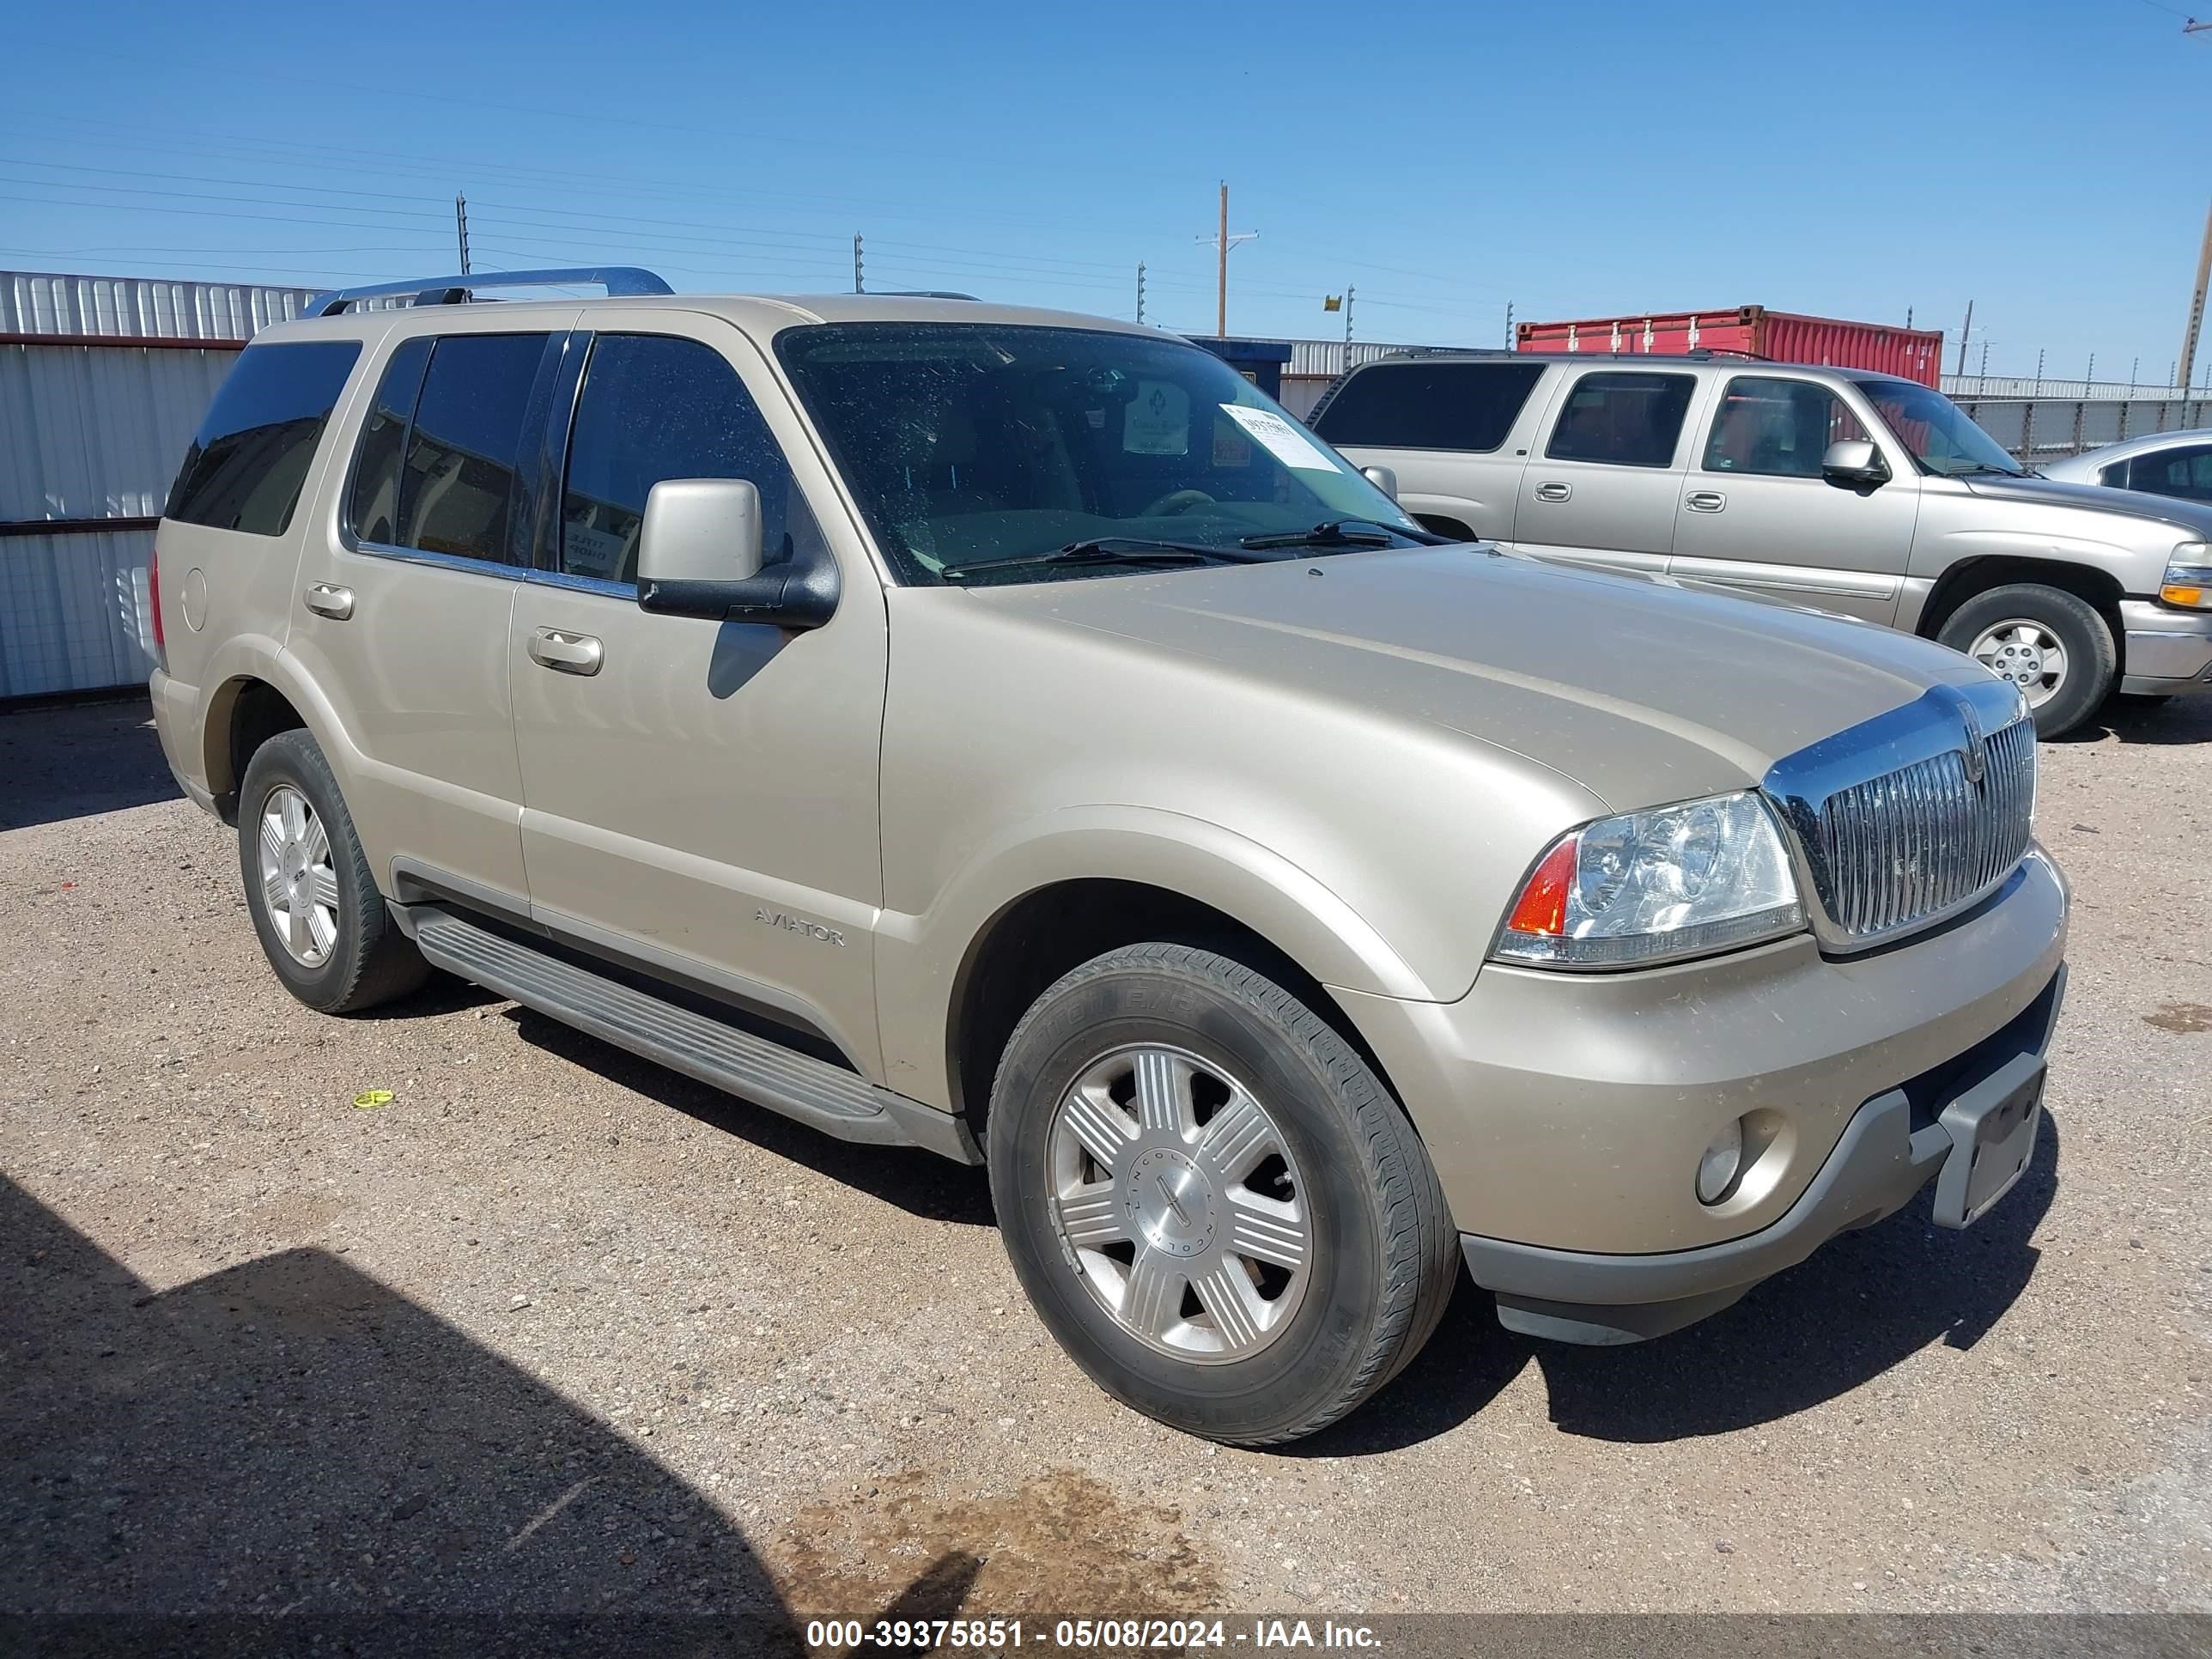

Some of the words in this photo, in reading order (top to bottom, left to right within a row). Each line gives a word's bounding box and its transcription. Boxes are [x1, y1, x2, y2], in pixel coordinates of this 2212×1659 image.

[755, 907, 845, 947] AVIATOR
[1133, 1152, 1194, 1210] LINCOLN
[1152, 1194, 1215, 1251] LINCOLN
